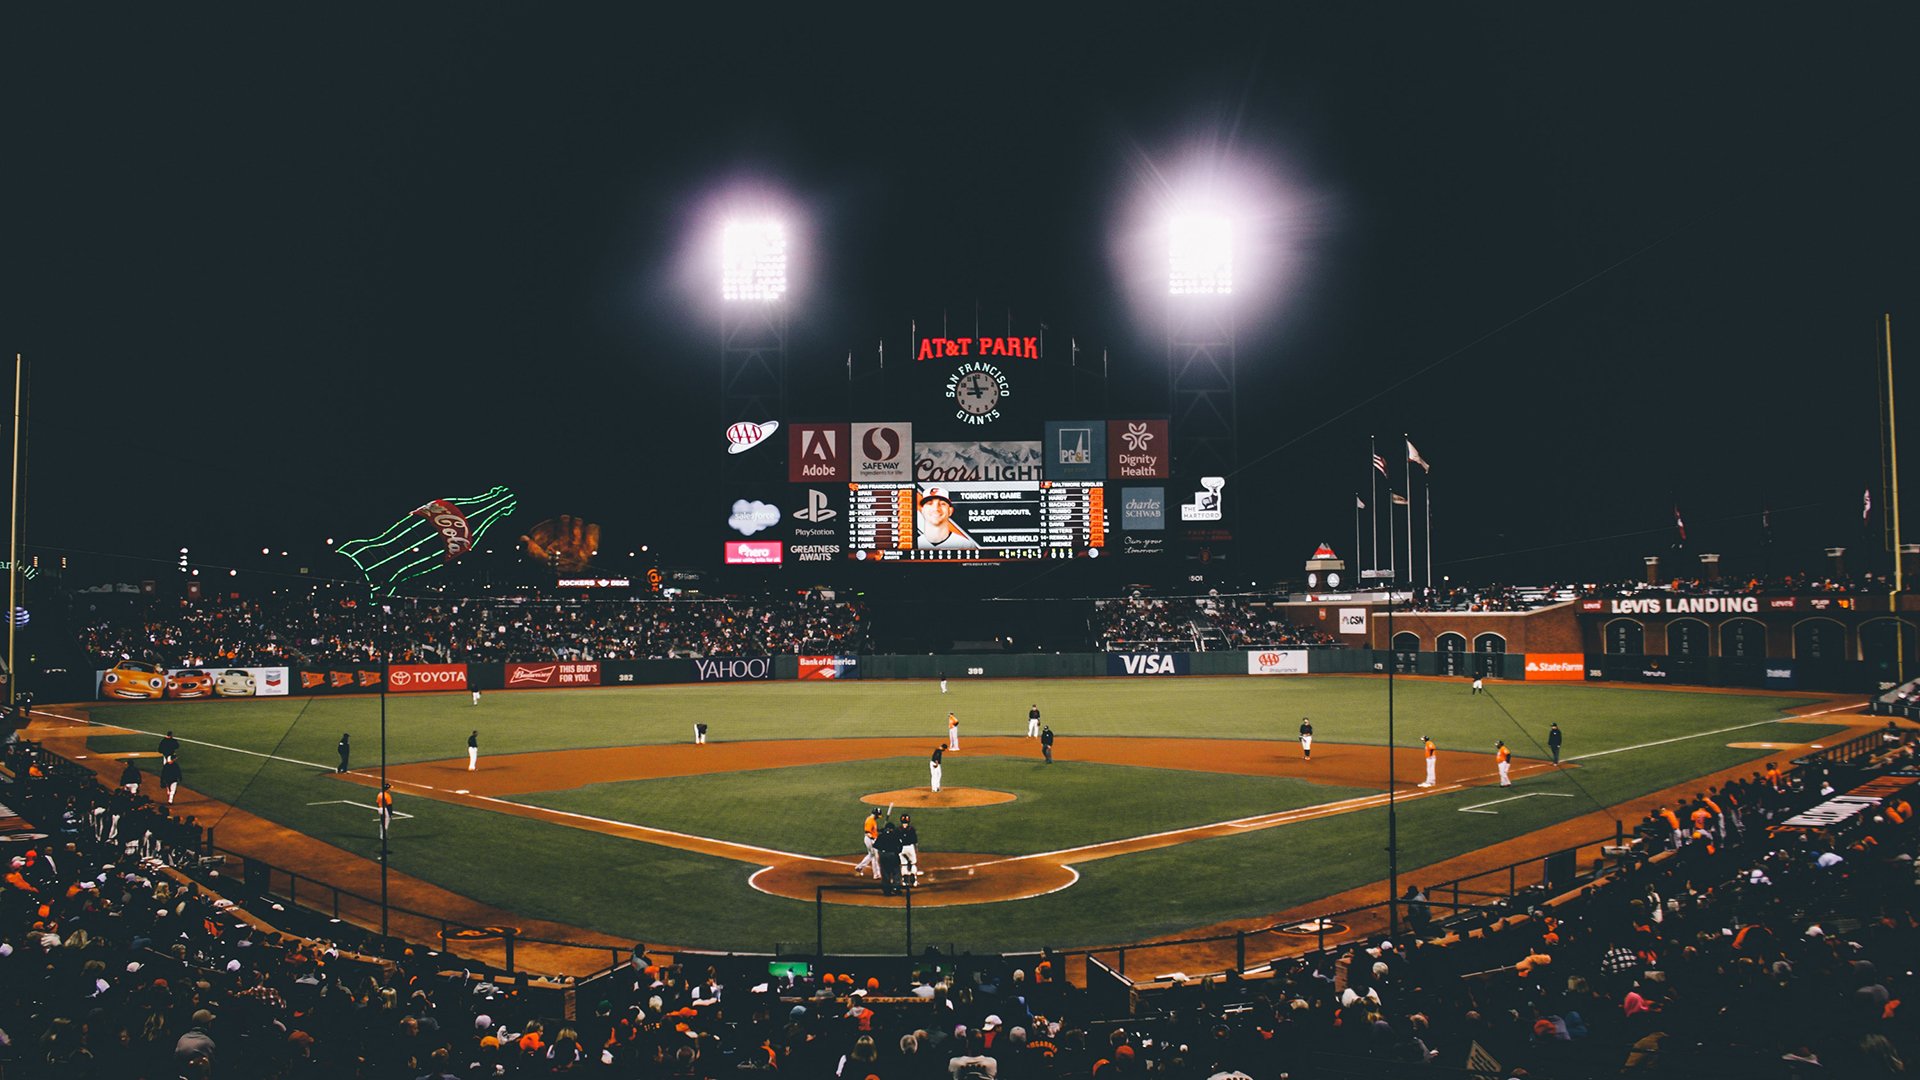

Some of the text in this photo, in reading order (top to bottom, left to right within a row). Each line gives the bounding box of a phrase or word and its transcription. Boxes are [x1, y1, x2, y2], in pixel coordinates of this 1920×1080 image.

[917, 337, 1038, 360] AT&T PARK
[946, 362, 1010, 398] SAN FRANCISCO
[956, 409, 1000, 424] GIANTS
[729, 424, 761, 443] AAA
[1061, 450, 1089, 462] PG&E
[1119, 454, 1157, 466] Dignity
[802, 464, 836, 476] Adobe
[862, 462, 899, 470] SAFEWAY
[915, 458, 1042, 480] Coors LIGHT
[1121, 466, 1156, 476] Health
[960, 492, 998, 500] TONIGHT'S
[1125, 499, 1160, 510] charles
[1125, 510, 1160, 518] SCHWAB
[434, 514, 471, 555] Cola
[795, 528, 834, 537] PlayStation
[790, 544, 840, 553] GREATNESS
[799, 552, 832, 561] AWAITS
[1666, 598, 1758, 613] LANDING
[1350, 616, 1364, 624] CSN
[800, 658, 856, 666] Bank of America
[1119, 655, 1175, 674] VISA
[559, 664, 597, 673] THIS BUD'S
[696, 658, 770, 680] YAHOO!
[412, 671, 466, 683] TOYOTA
[514, 670, 552, 679] Budweiser
[560, 674, 590, 682] FOR YOU.
